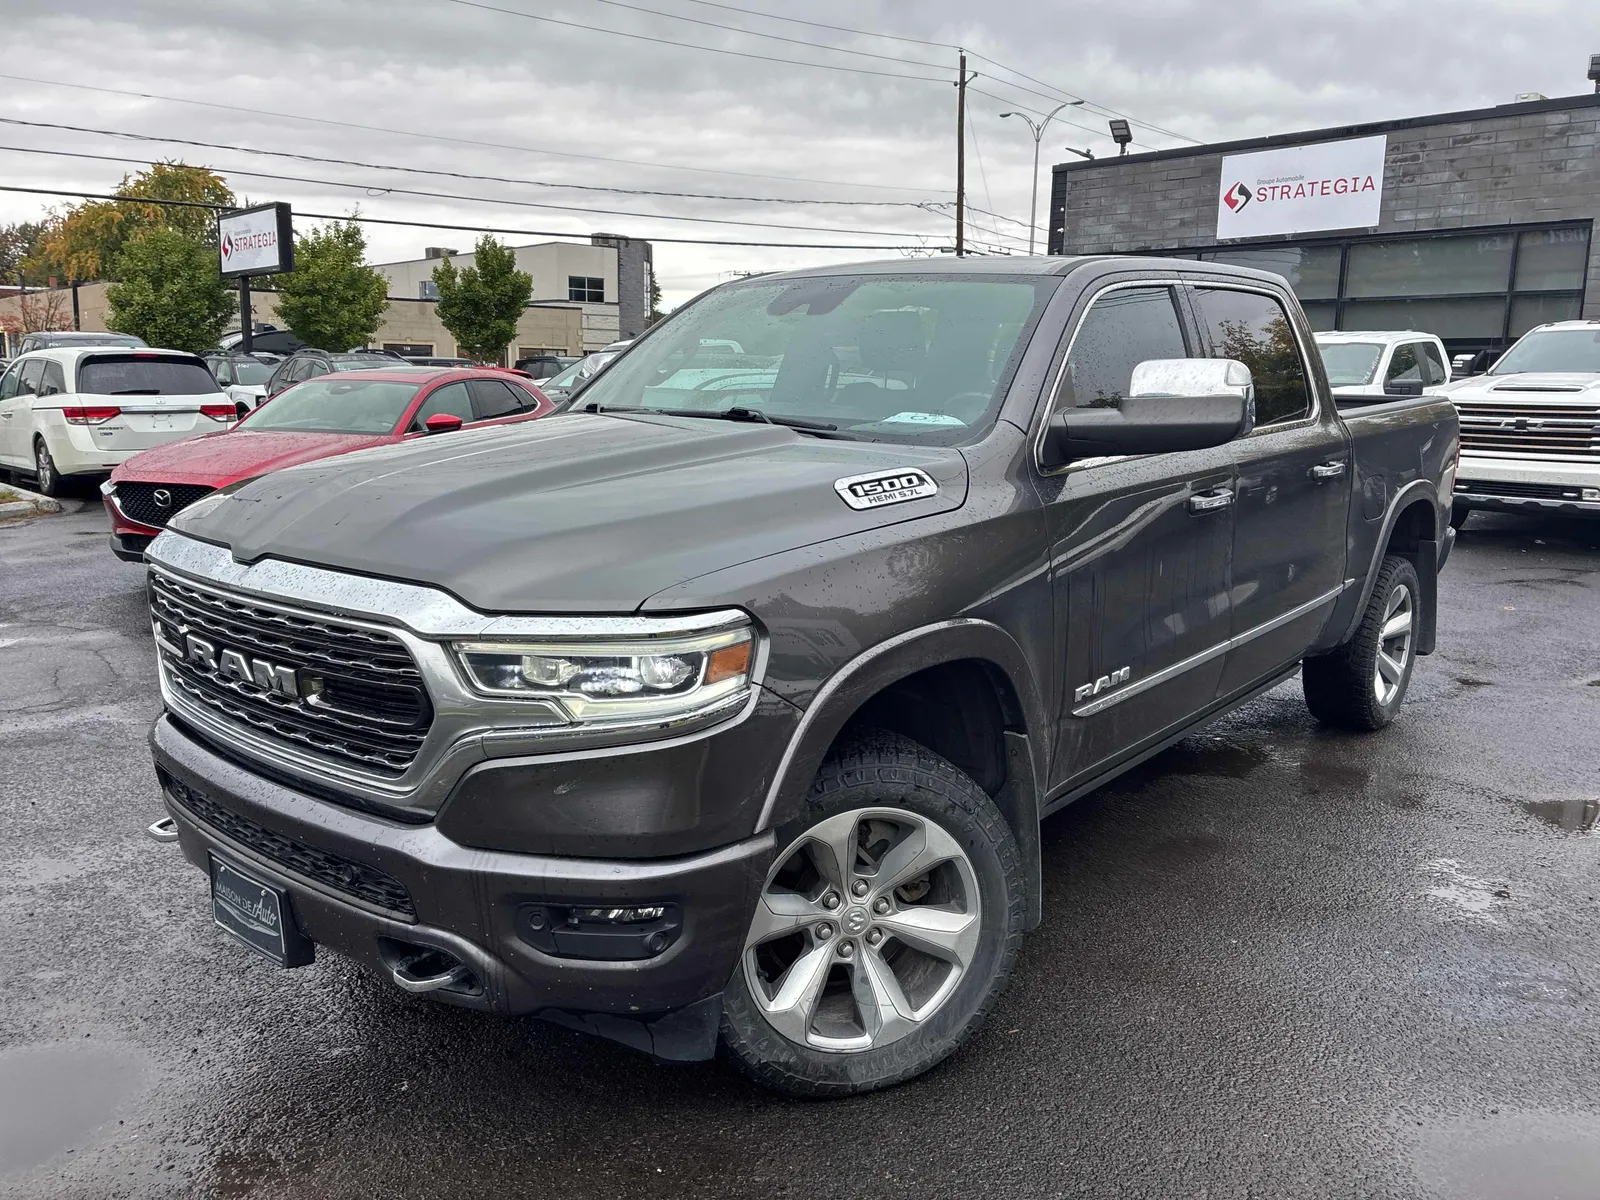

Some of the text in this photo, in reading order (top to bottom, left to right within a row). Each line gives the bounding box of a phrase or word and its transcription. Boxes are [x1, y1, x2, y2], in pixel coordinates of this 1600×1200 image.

[1256, 175, 1376, 203] STRATEGIA
[233, 230, 277, 252] STRATEGIA
[851, 475, 920, 497] 1500
[867, 490, 922, 504] HEMI 5.7L
[185, 633, 299, 698] RAM
[1074, 665, 1131, 703] RAM
[216, 881, 241, 906] MAISON
[242, 897, 252, 912] DE
